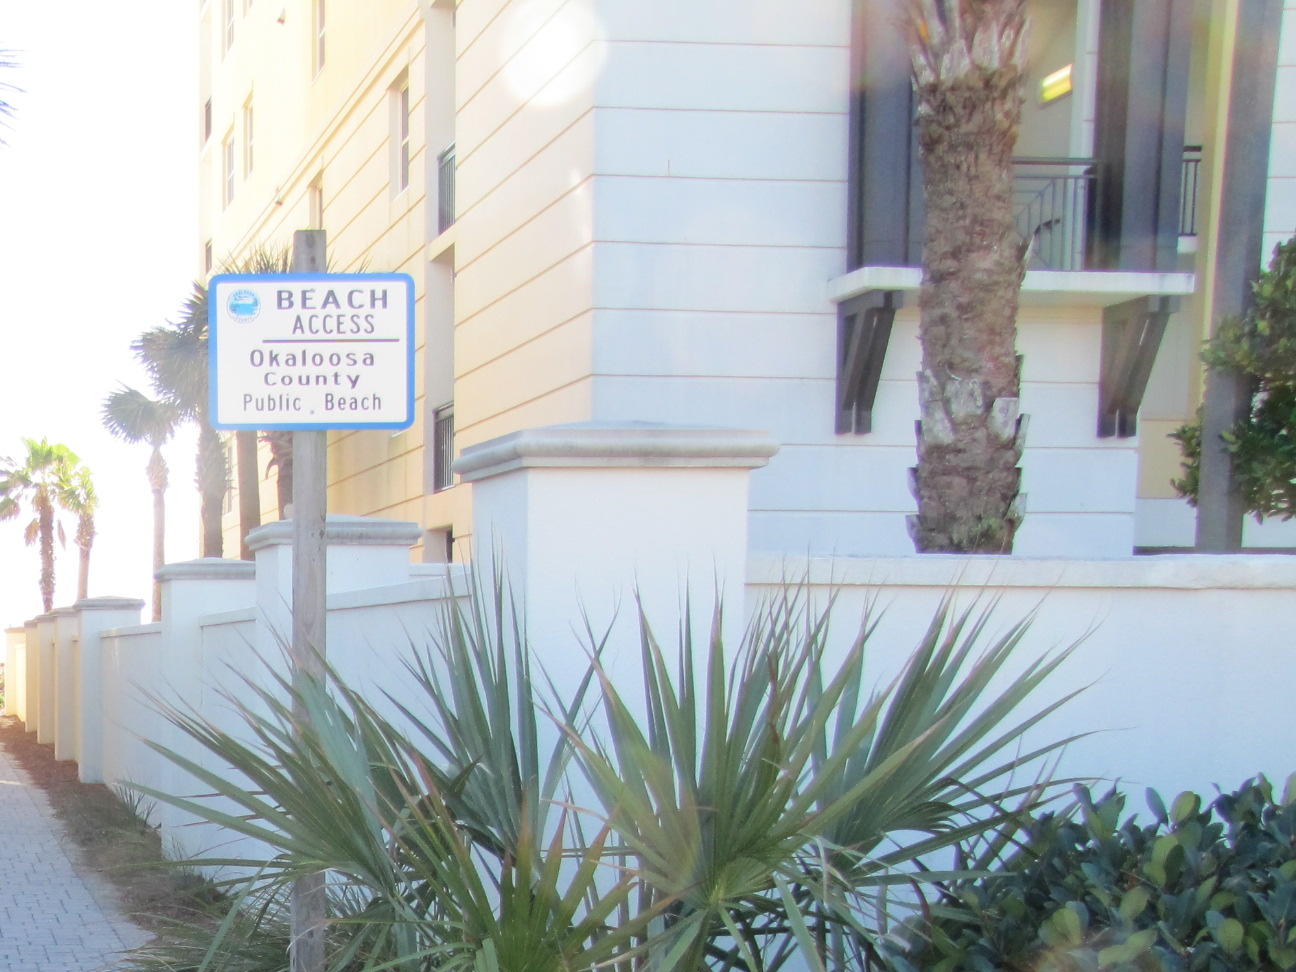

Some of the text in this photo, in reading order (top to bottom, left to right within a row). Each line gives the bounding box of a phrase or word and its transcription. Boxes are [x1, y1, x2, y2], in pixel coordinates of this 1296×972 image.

[277, 289, 387, 310] BEACH
[292, 314, 374, 334] ACCESS
[250, 349, 374, 367] Okaloosa
[264, 372, 360, 389] County
[244, 393, 381, 411] Public Beach
